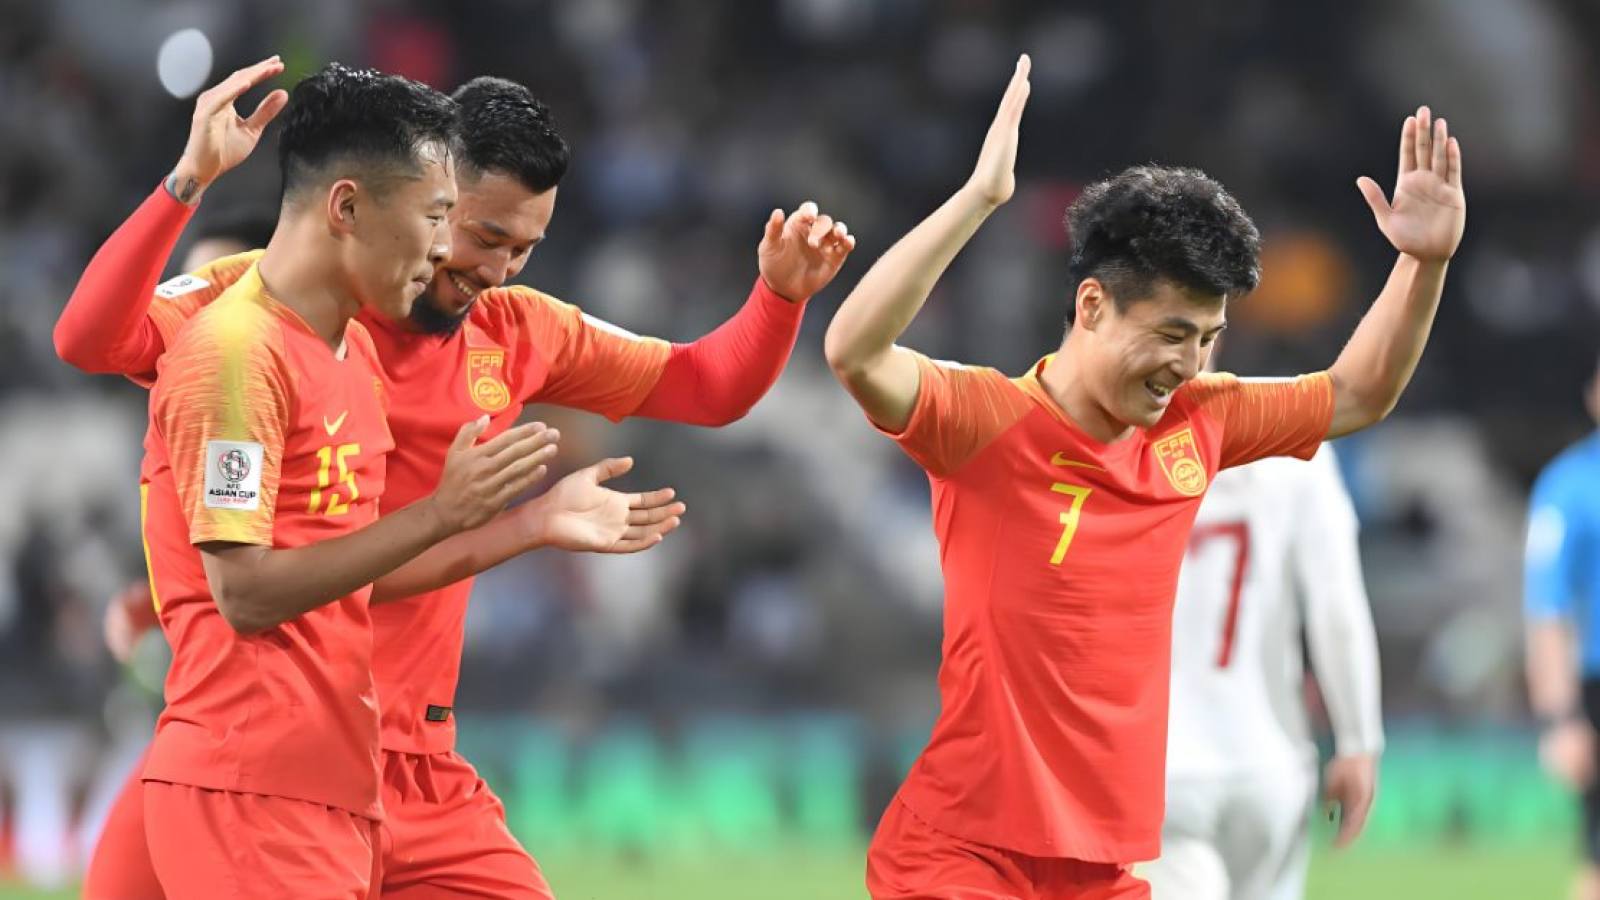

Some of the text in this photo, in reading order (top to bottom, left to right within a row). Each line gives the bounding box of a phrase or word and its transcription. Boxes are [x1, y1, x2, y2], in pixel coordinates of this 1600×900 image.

[209, 488, 256, 499] ASIAN CUP
[308, 443, 360, 516] 15
[1050, 482, 1093, 565] 7
